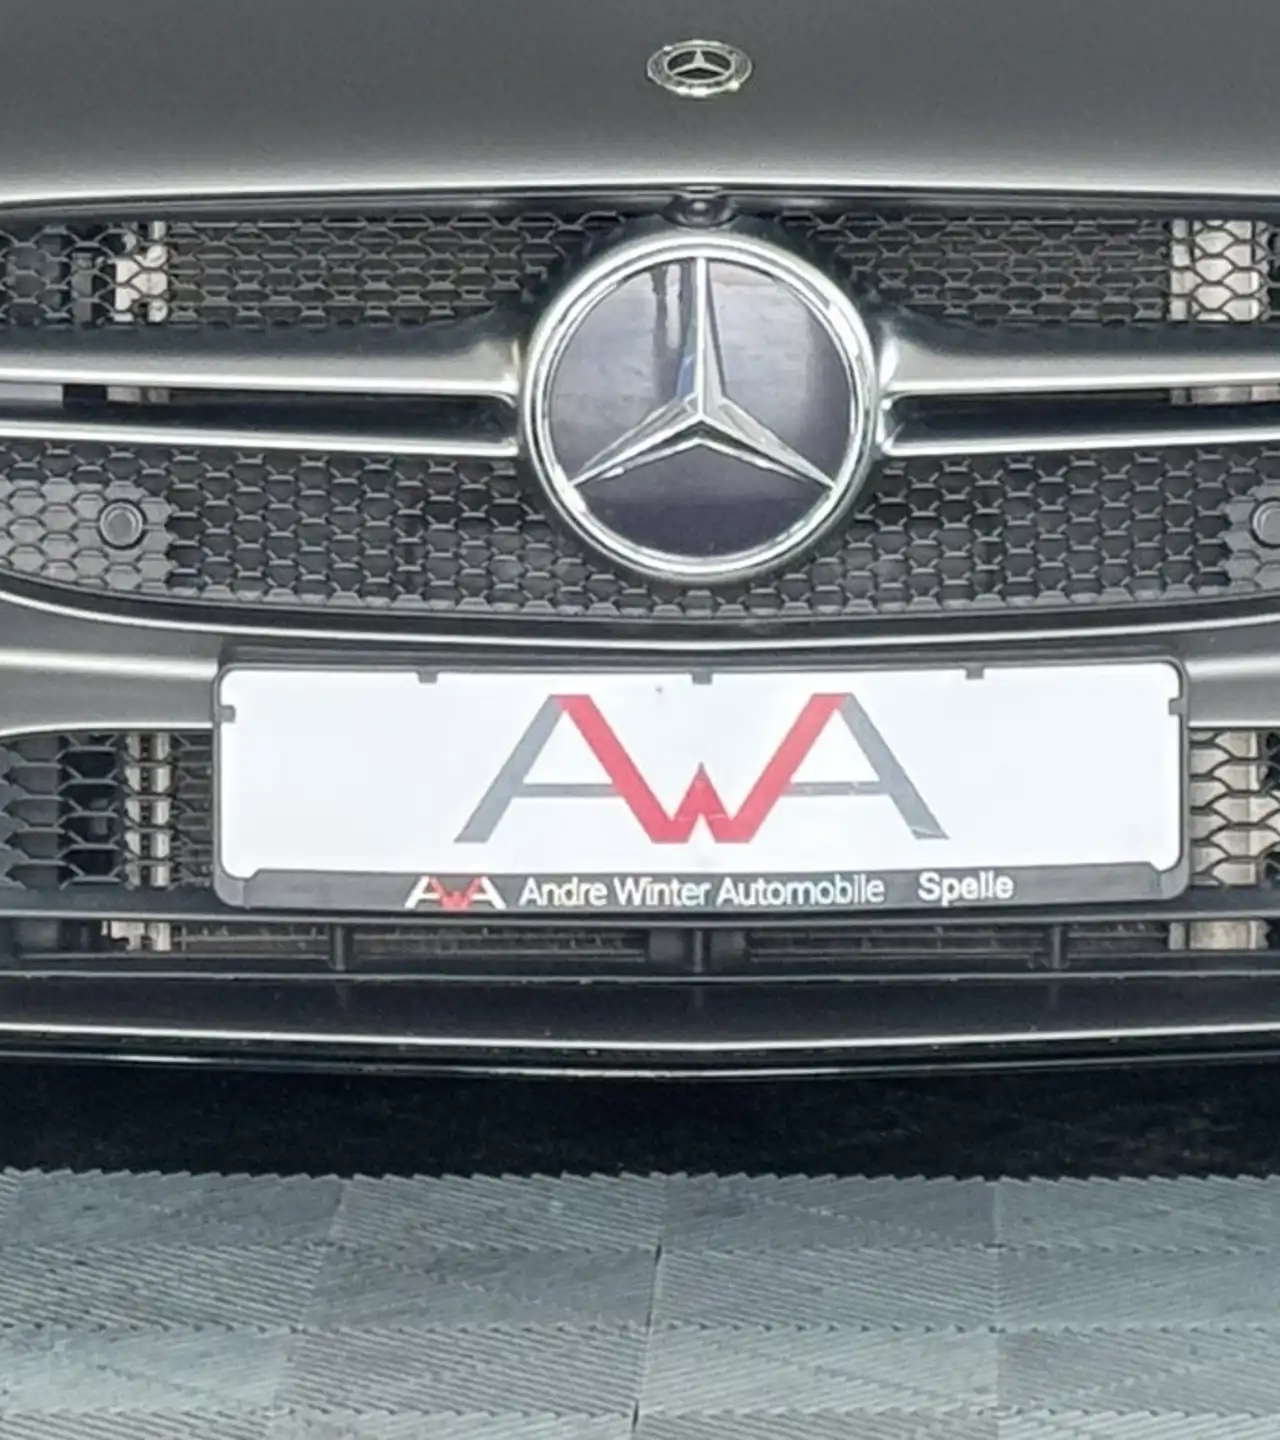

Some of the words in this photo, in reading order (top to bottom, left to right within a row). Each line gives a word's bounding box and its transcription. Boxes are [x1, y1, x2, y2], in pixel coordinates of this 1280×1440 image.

[519, 876, 608, 907] Andre
[612, 875, 713, 907] Winter
[716, 873, 886, 906] Automobile
[918, 870, 1014, 906] Spelle
